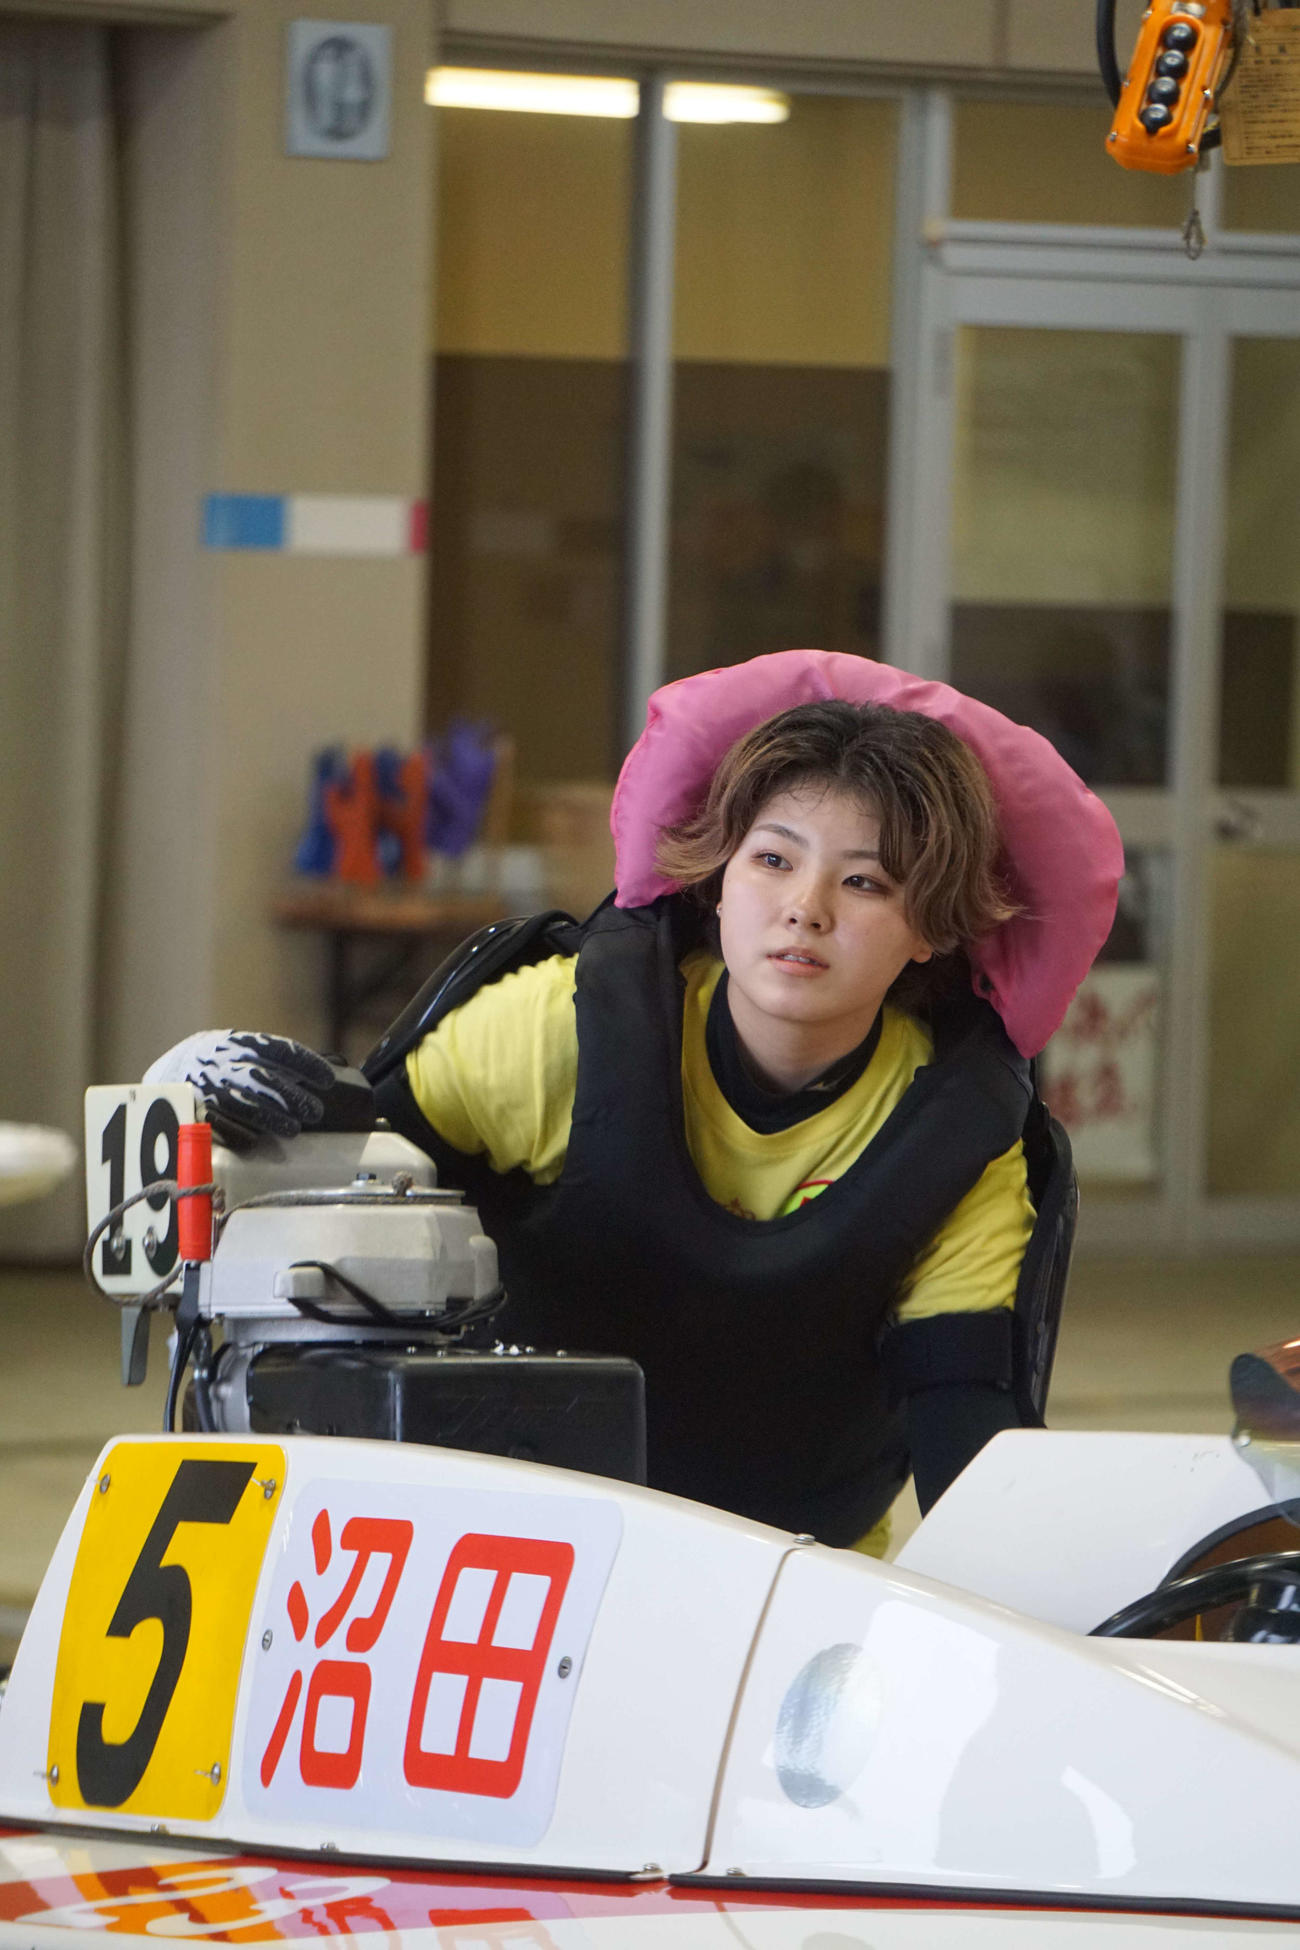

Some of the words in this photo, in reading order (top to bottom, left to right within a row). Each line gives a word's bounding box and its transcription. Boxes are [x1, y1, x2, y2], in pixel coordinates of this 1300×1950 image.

[102, 1098, 181, 1276] 19
[76, 1459, 258, 1808] 5
[260, 1508, 576, 1800] 沼田
